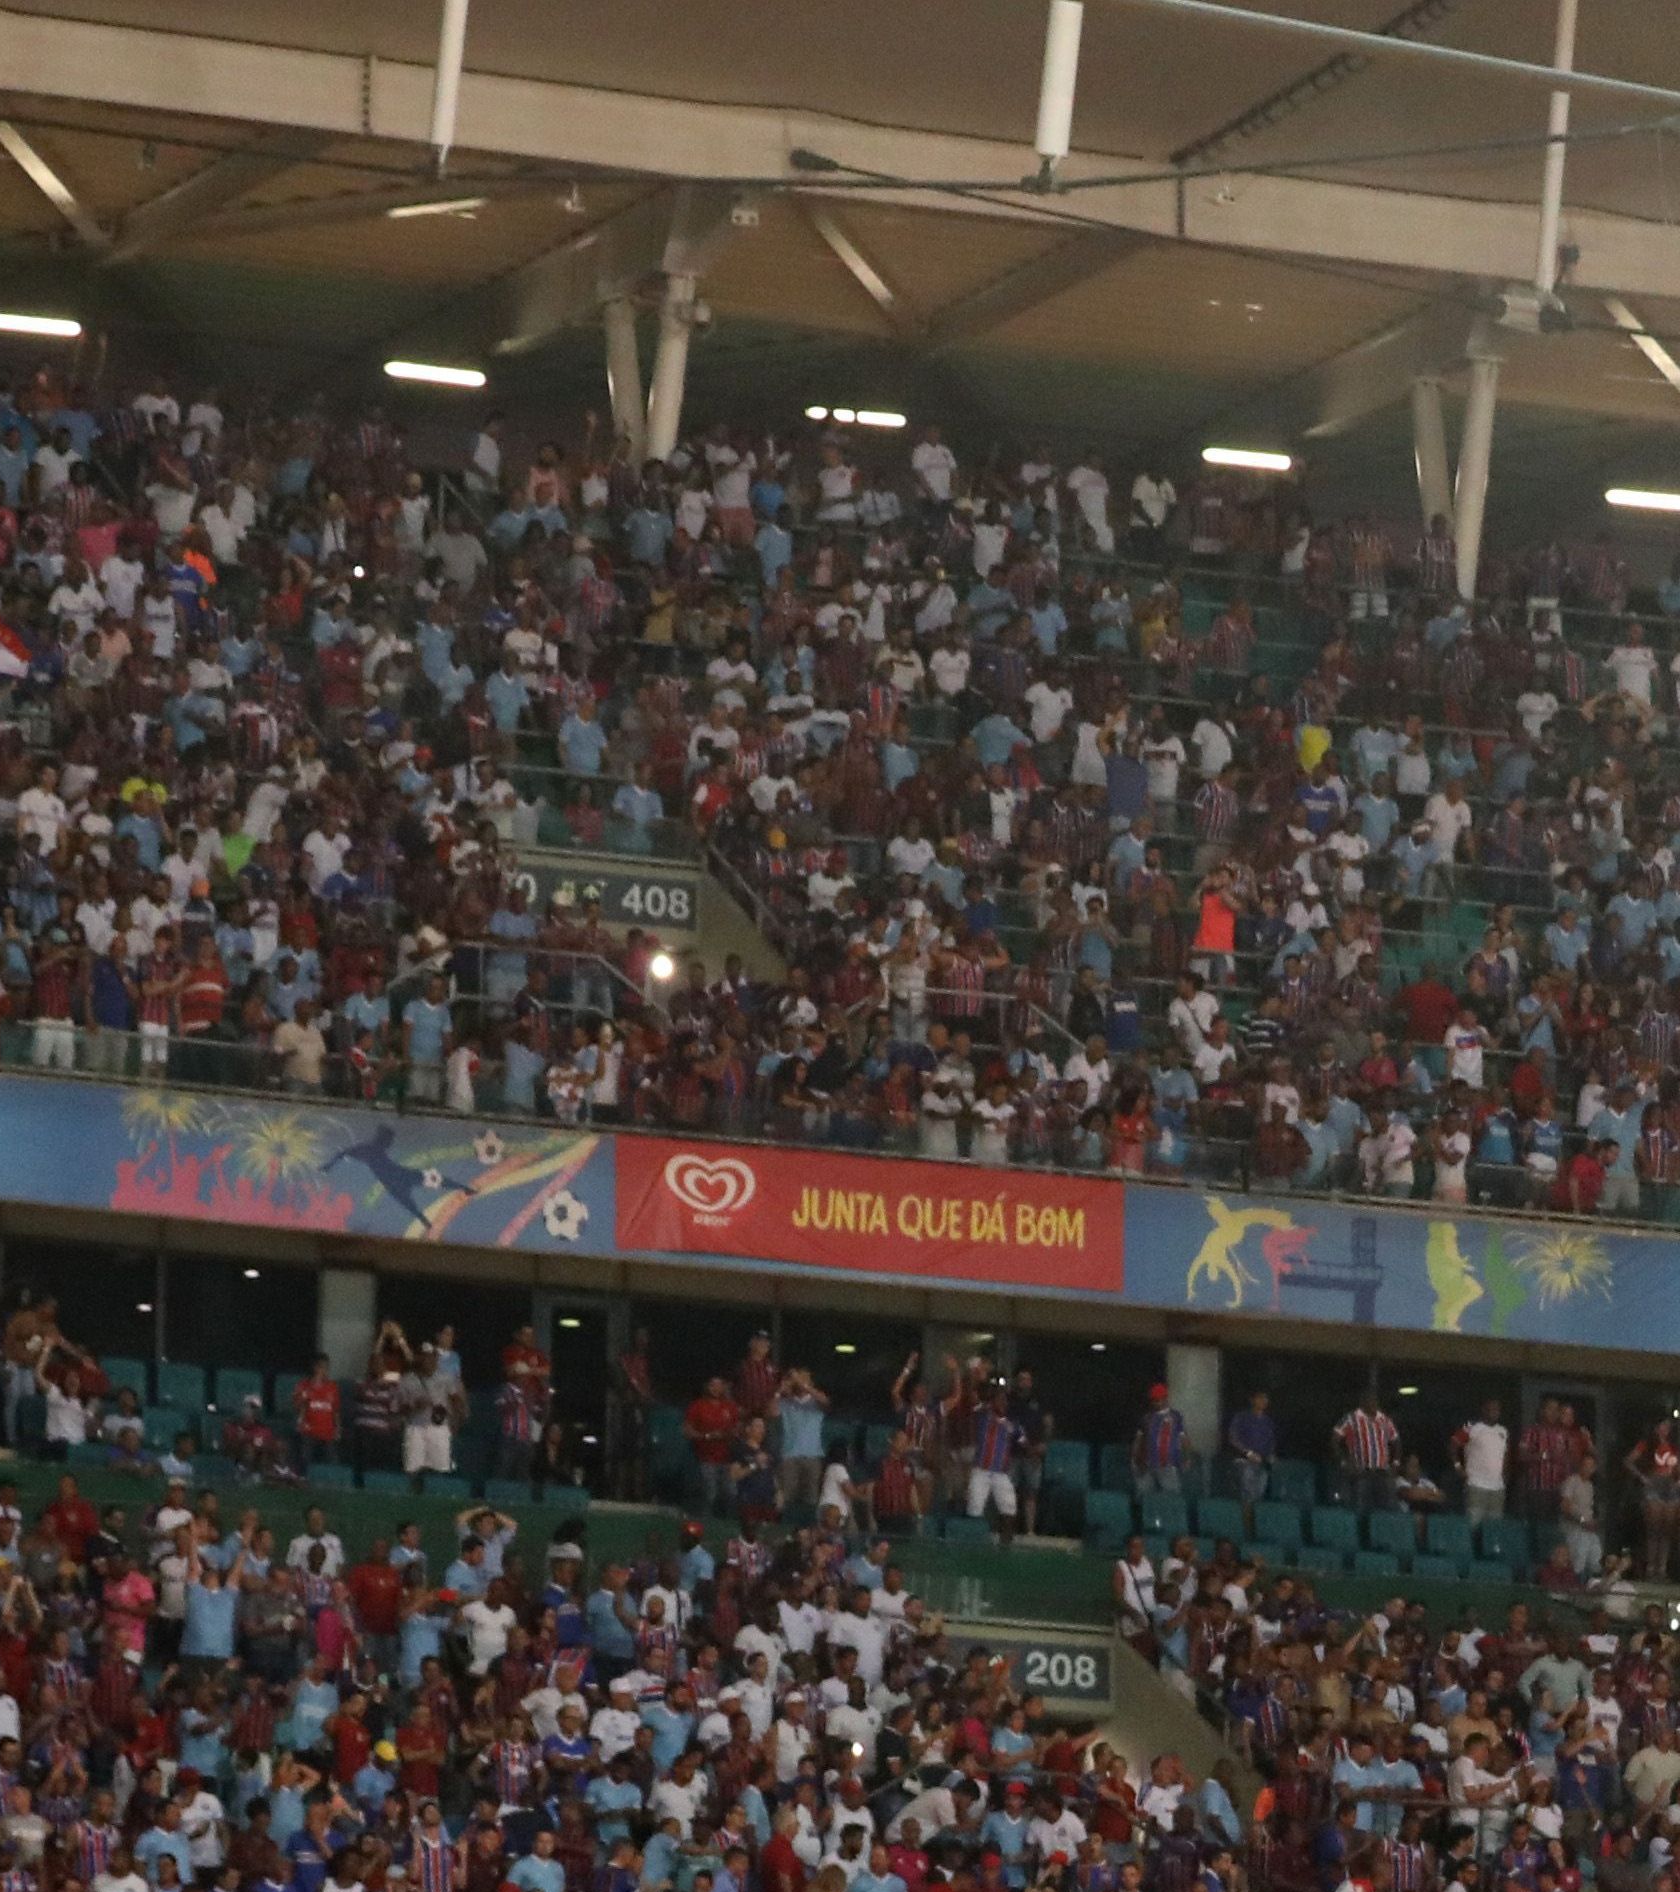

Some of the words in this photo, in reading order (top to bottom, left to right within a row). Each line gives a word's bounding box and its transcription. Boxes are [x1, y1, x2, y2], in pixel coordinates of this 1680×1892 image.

[621, 884, 691, 921] 408
[791, 1187, 890, 1236] JUNTA
[896, 1194, 964, 1241] QUE
[970, 1192, 1008, 1244] DÁ
[1016, 1203, 1087, 1251] BOM
[1025, 1651, 1098, 1690] 208
